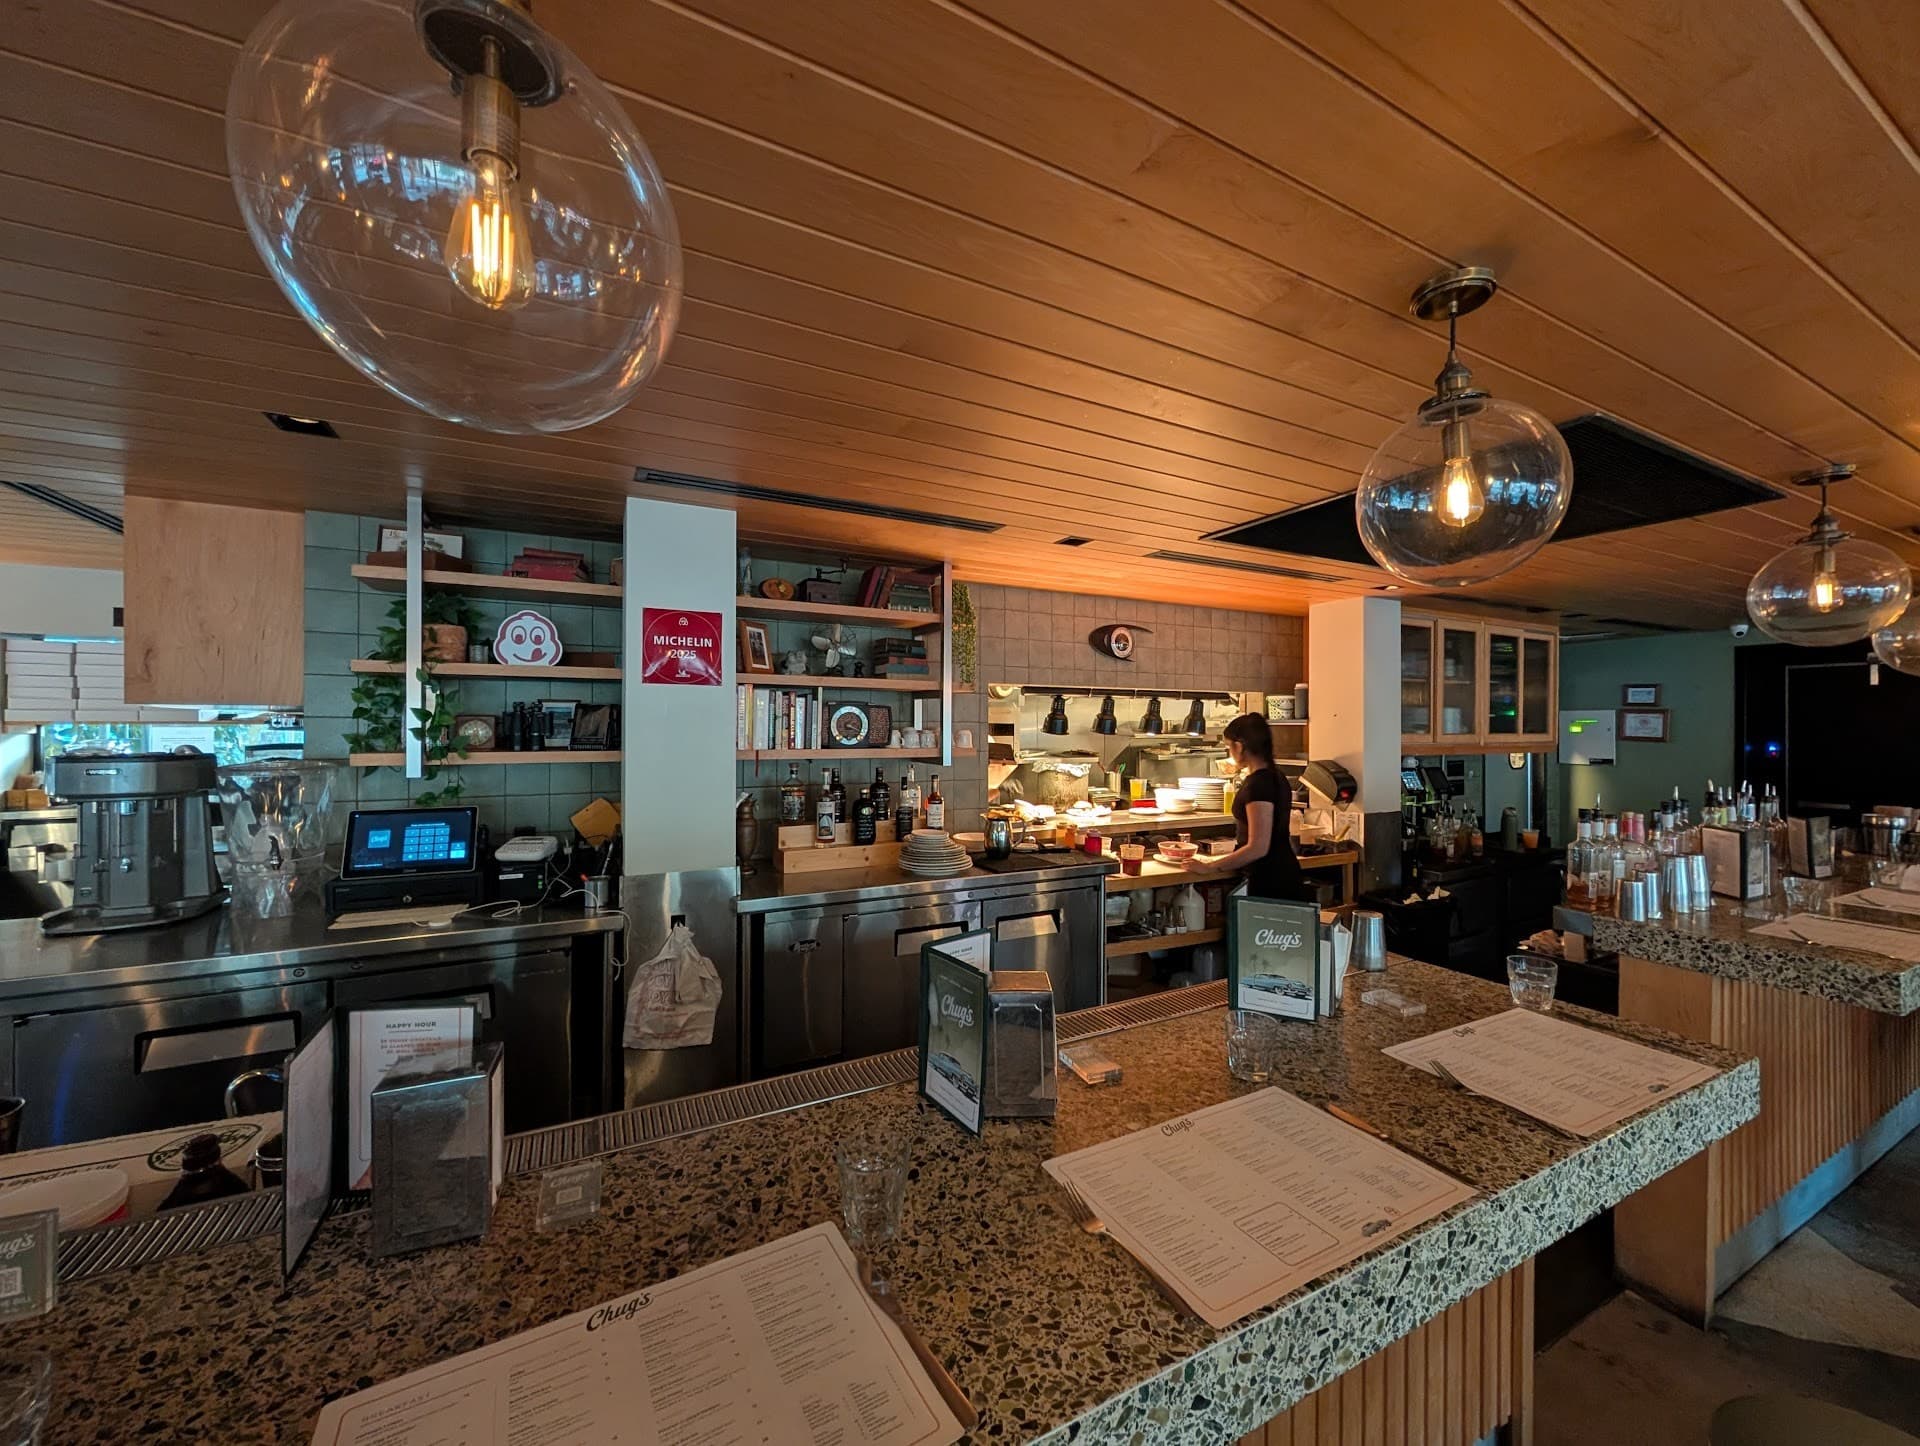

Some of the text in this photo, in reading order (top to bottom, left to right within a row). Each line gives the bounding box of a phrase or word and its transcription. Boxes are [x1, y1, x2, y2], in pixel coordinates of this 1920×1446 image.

[653, 635, 713, 648] MICHELIN
[670, 649, 697, 659] 2025
[1254, 928, 1303, 952] Chug's
[940, 993, 975, 1029] Chug's
[1160, 1117, 1195, 1137] Chug's
[0, 1232, 36, 1260] ug's
[586, 1292, 655, 1332] Chug's
